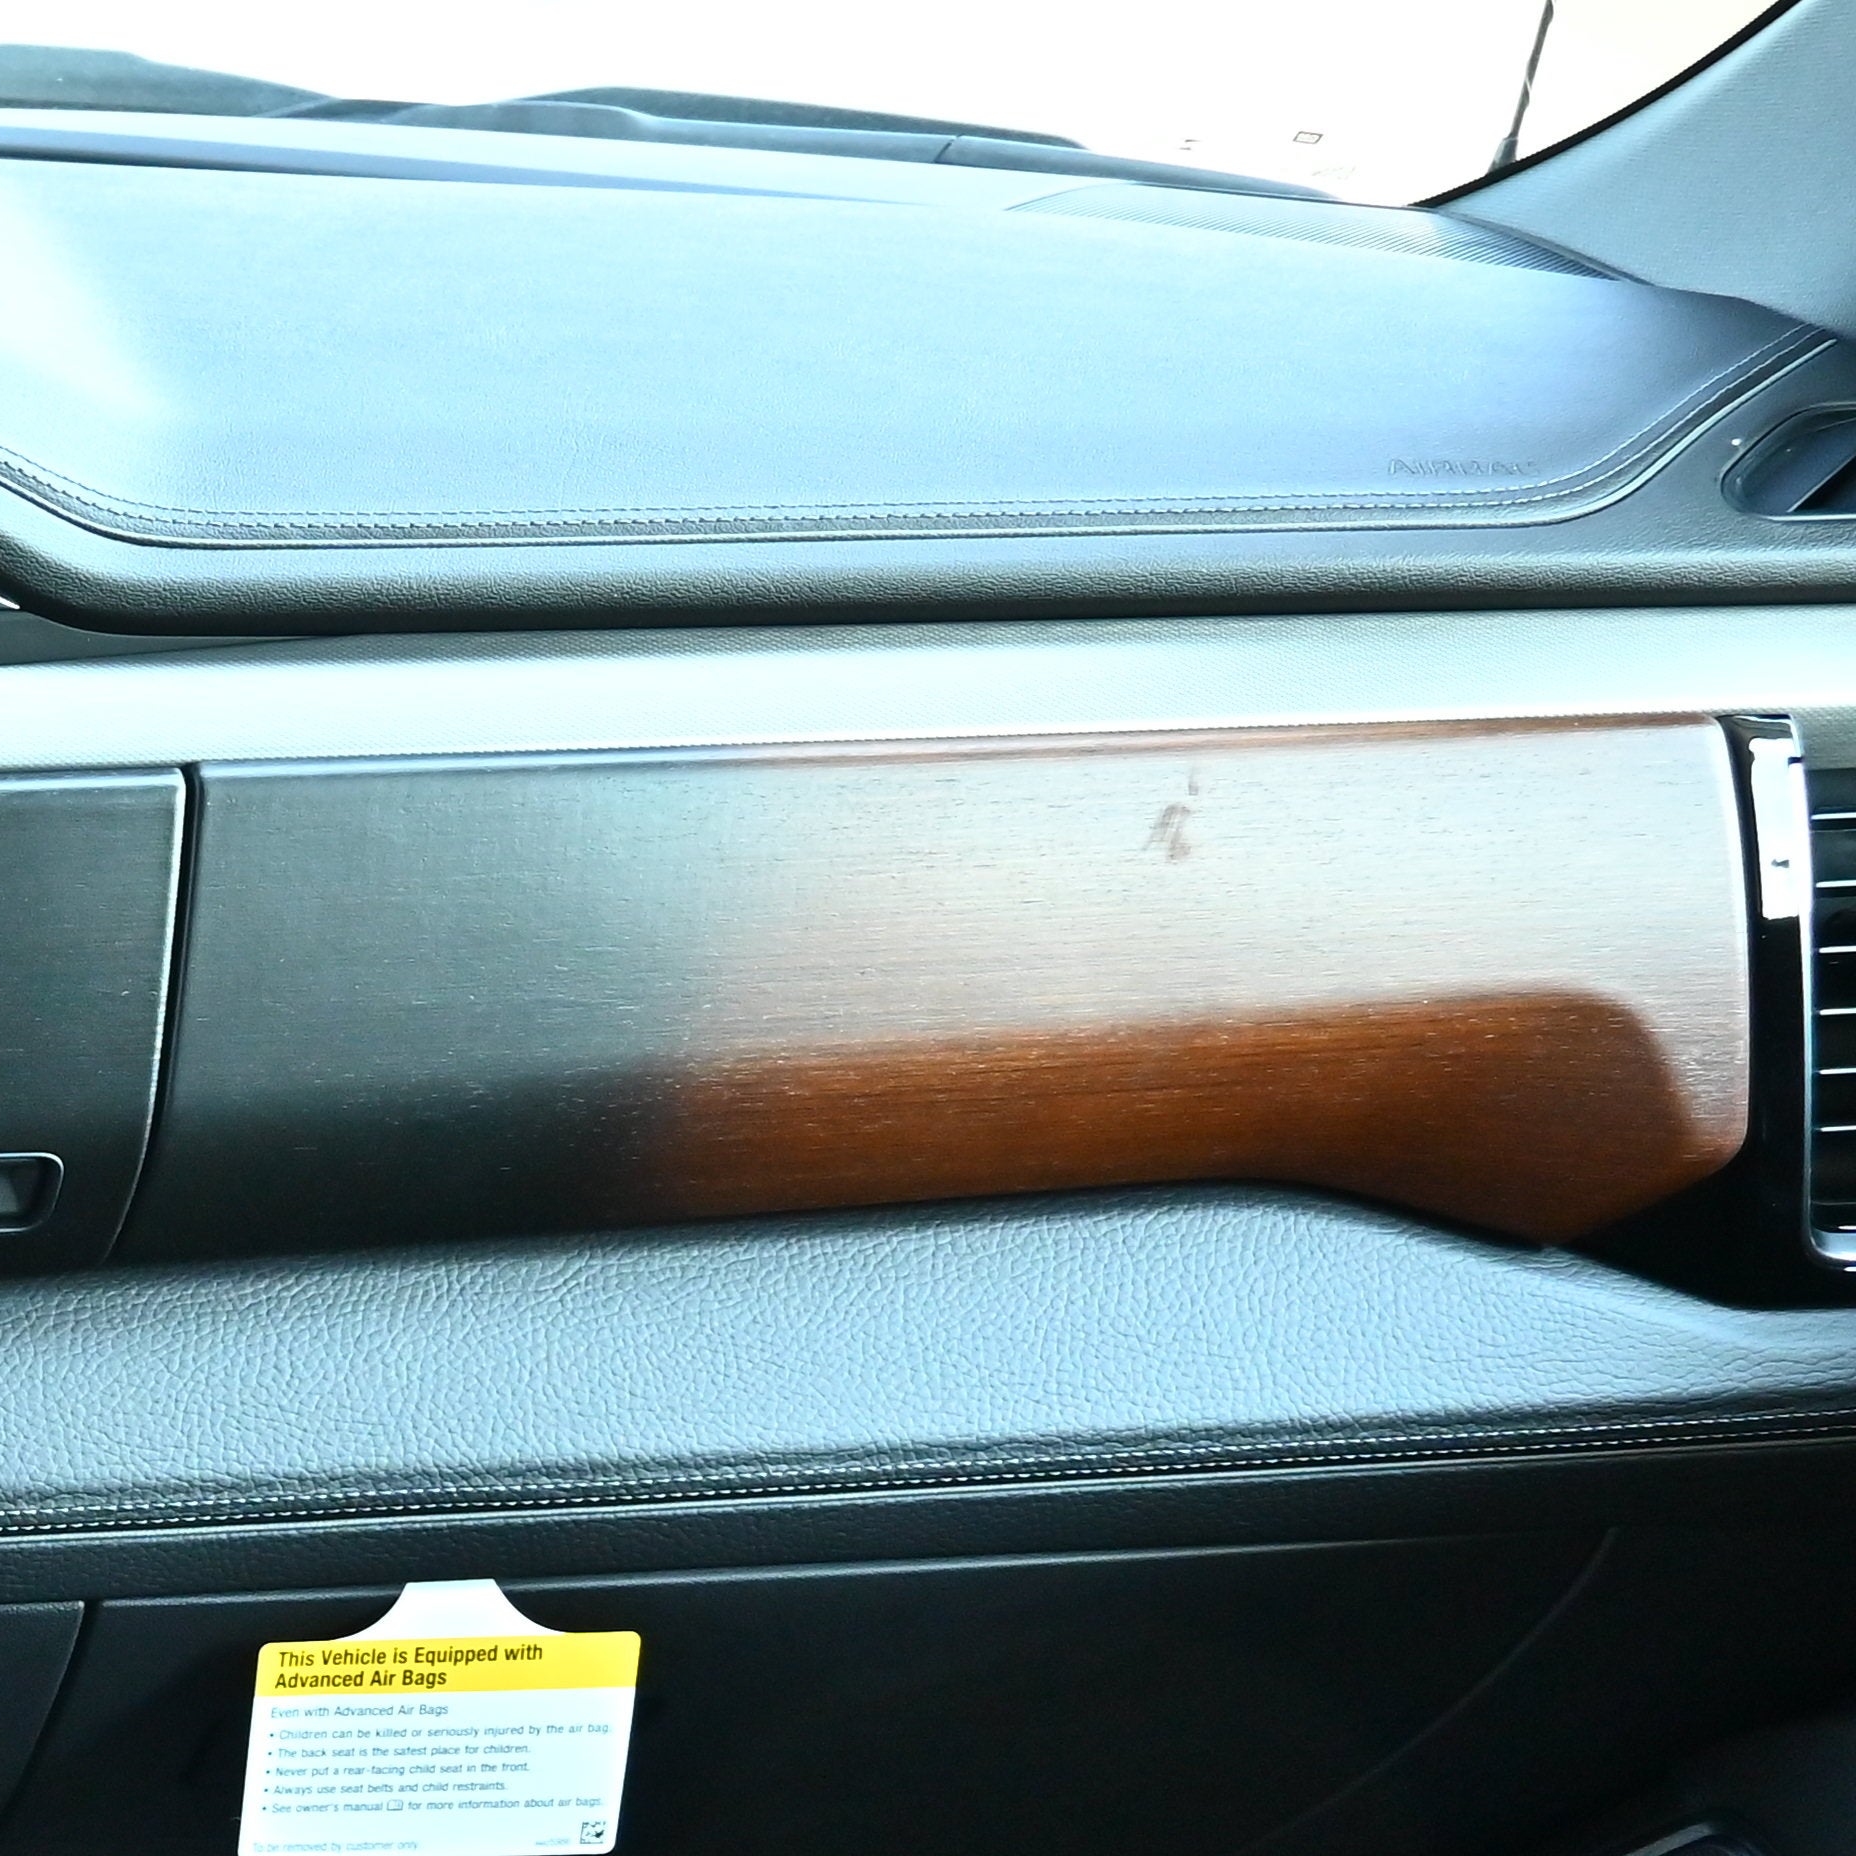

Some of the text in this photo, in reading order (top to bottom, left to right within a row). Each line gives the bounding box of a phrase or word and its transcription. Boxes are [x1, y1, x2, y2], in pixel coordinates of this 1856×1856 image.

[280, 1644, 543, 1667] This Vehicle is Equipped with
[275, 1670, 447, 1689] Advanced Air Bags
[271, 1704, 448, 1719] Even with Advanced Air Bags
[280, 1729, 327, 1740] Children
[332, 1730, 352, 1739] can
[357, 1728, 371, 1739] be
[376, 1728, 407, 1738] killed
[411, 1729, 422, 1738] or
[428, 1727, 479, 1738] seriously
[484, 1725, 524, 1738] injured
[528, 1725, 541, 1737] by
[546, 1725, 564, 1735] the
[569, 1724, 583, 1734] air
[278, 1748, 297, 1758] The
[301, 1747, 327, 1758] back
[331, 1747, 355, 1757] seat
[359, 1747, 368, 1757] is
[372, 1746, 389, 1757] the
[465, 1744, 479, 1754] for
[275, 1766, 308, 1777] Never
[311, 1766, 329, 1778] put
[409, 1764, 435, 1774] child
[440, 1763, 462, 1774] seat
[481, 1763, 498, 1773] the
